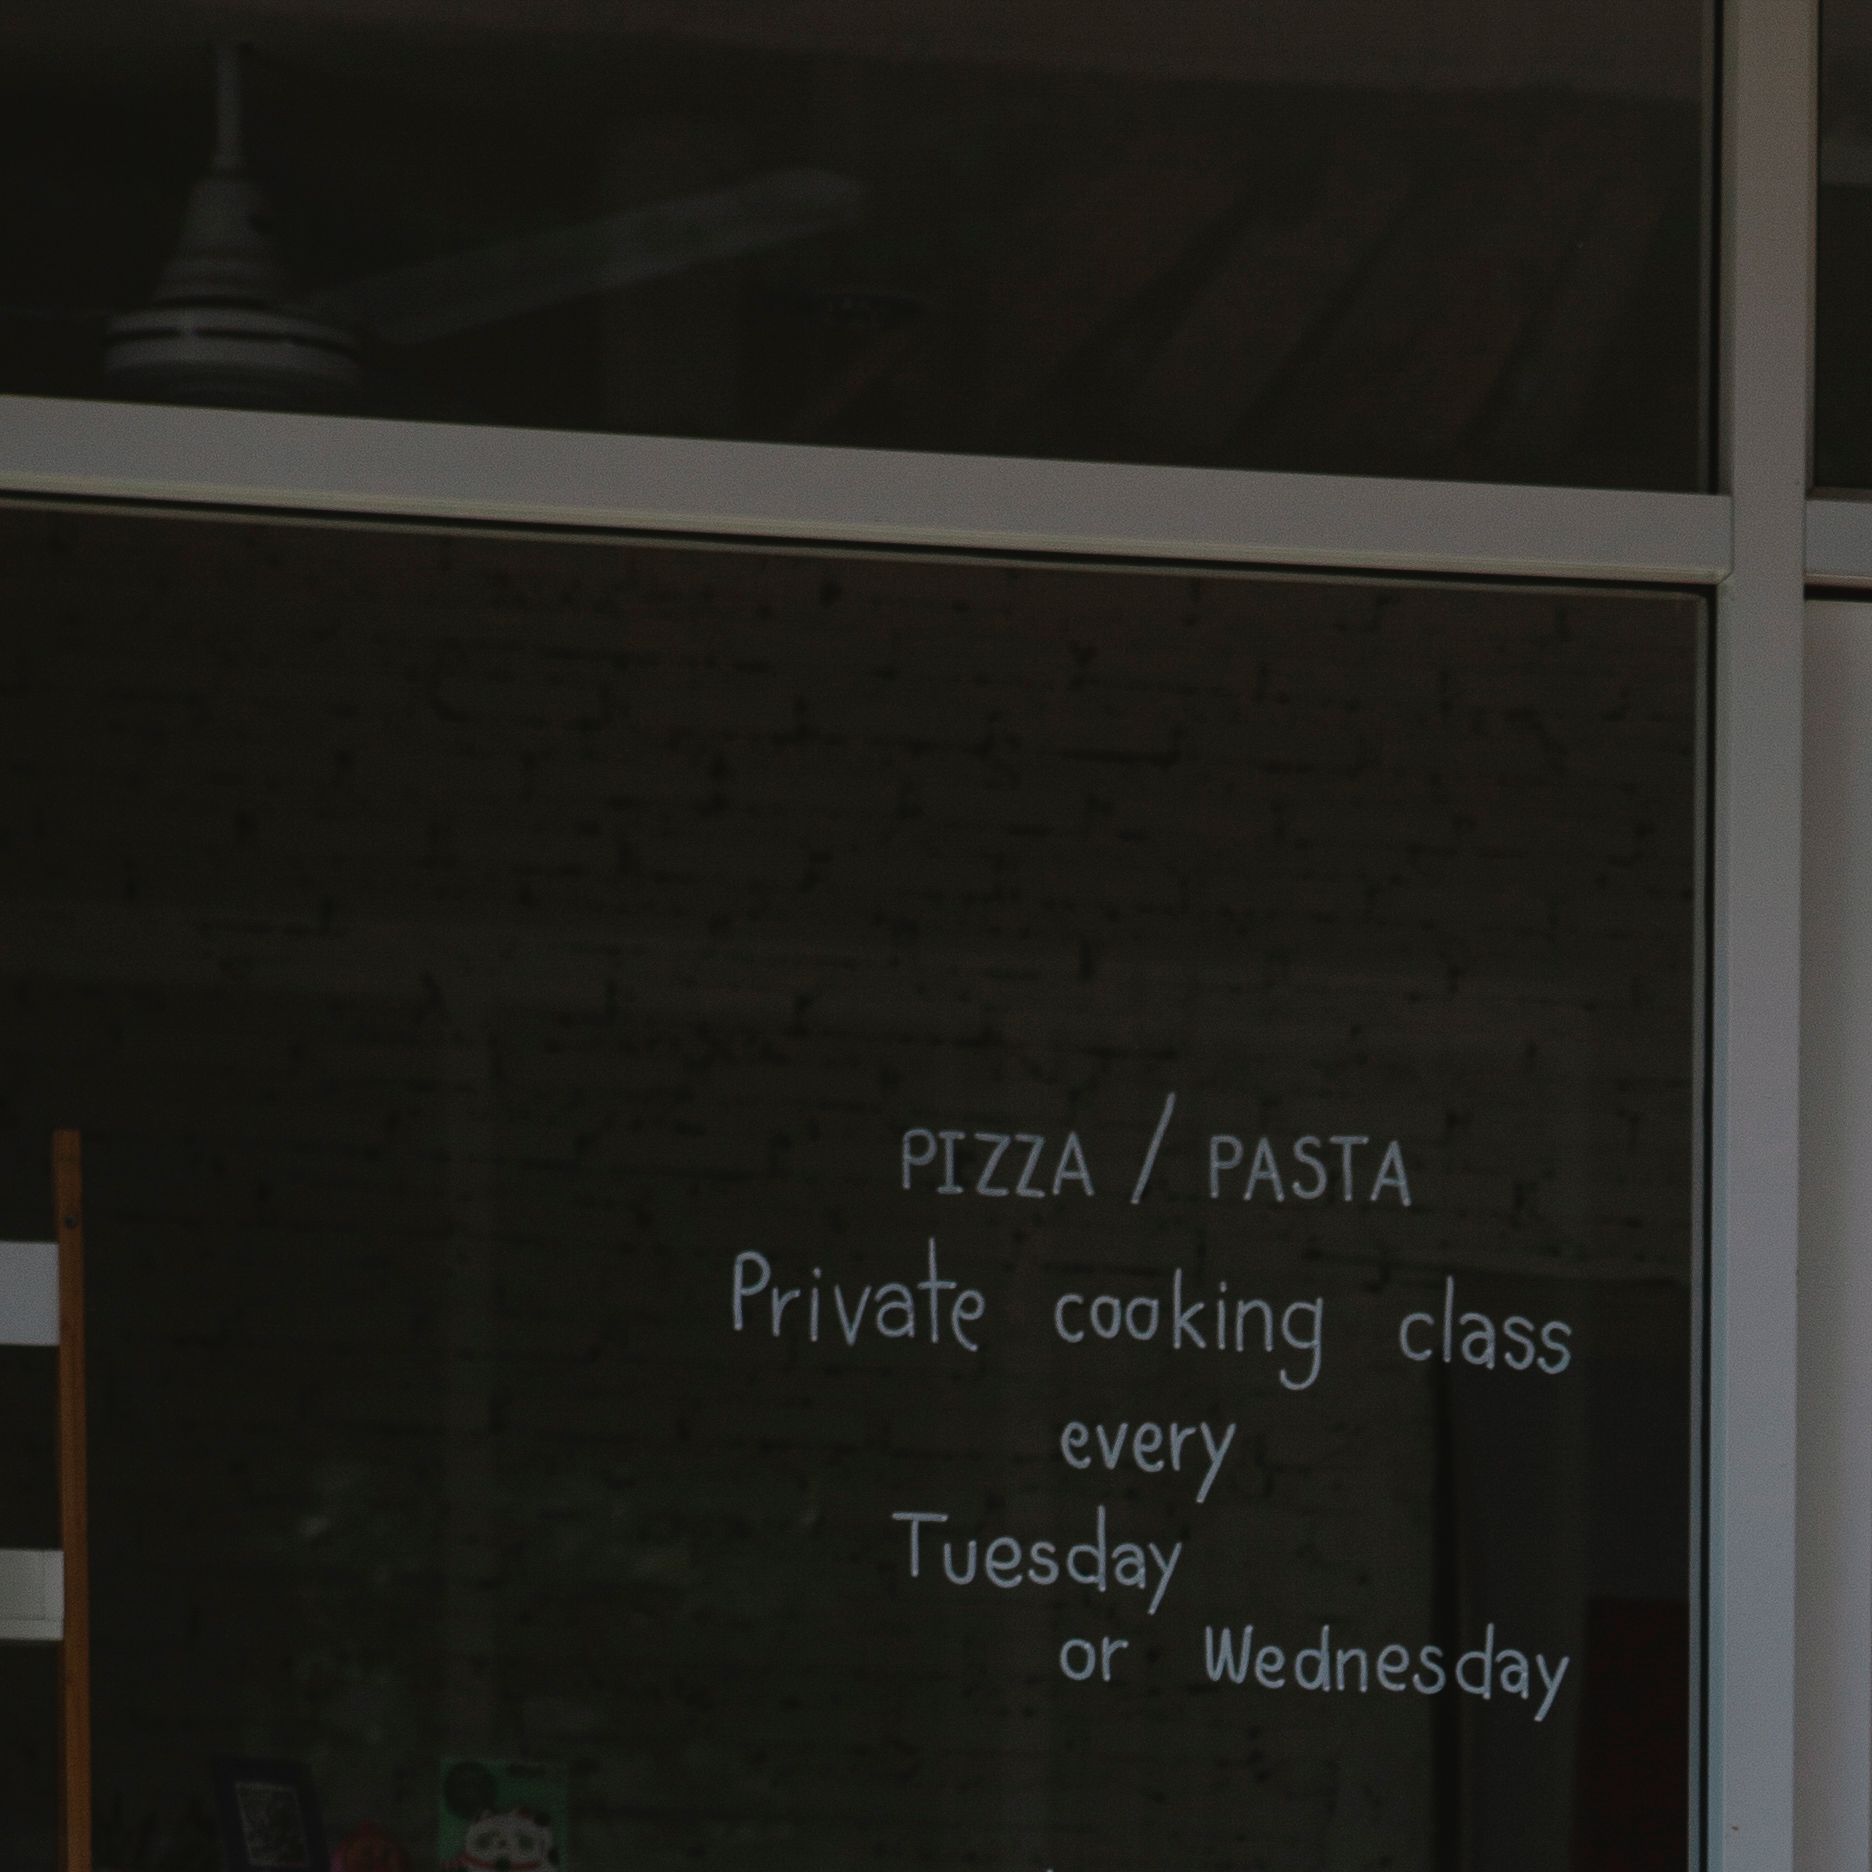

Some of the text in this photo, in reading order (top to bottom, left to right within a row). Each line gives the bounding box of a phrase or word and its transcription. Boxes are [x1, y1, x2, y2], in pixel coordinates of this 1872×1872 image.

[901, 1127, 1094, 1198] PIZZA
[1208, 1133, 1411, 1206] PASTA
[731, 1239, 1573, 1391] Private cooking class
[1060, 1419, 1236, 1503] every
[892, 1505, 1183, 1615] Tuesday
[1059, 1623, 1570, 1720] or Wednesday
